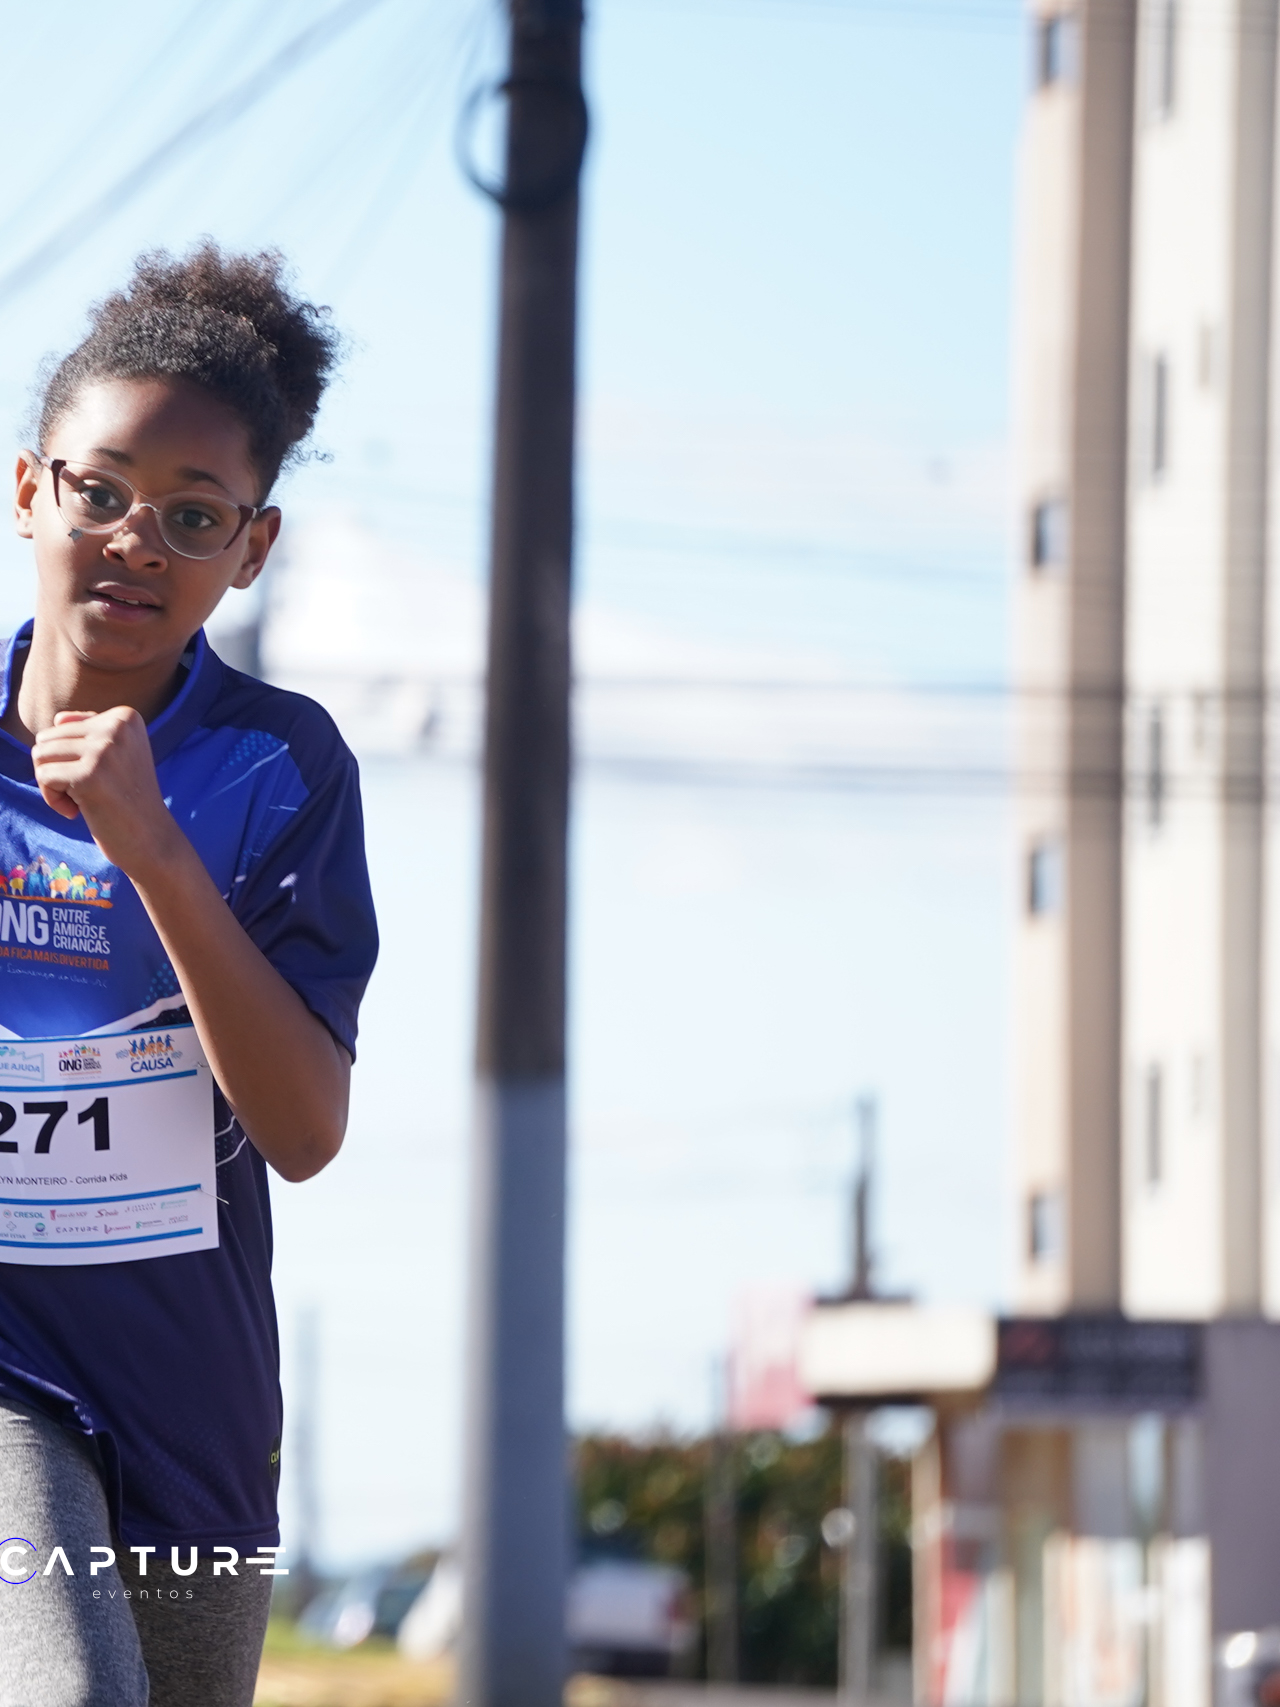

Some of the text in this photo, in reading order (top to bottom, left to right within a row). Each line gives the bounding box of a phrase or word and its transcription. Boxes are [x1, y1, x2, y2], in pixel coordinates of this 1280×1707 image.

[52, 907, 91, 925] ENTRE
[53, 922, 107, 940] AMIGOS E
[11, 947, 32, 960] FICA
[34, 950, 58, 963] MAIS
[59, 953, 110, 970] DIVERTIDA
[10, 1063, 41, 1073] AJUDA
[59, 1059, 82, 1072] ONG
[130, 1057, 174, 1073] CAUSA
[16, 1176, 68, 1186] MONTEIRO
[75, 1175, 107, 1185] Corrida
[109, 1172, 128, 1182] Kids
[13, 1211, 45, 1219] CRESOL
[55, 1225, 99, 1234] CAPTURE
